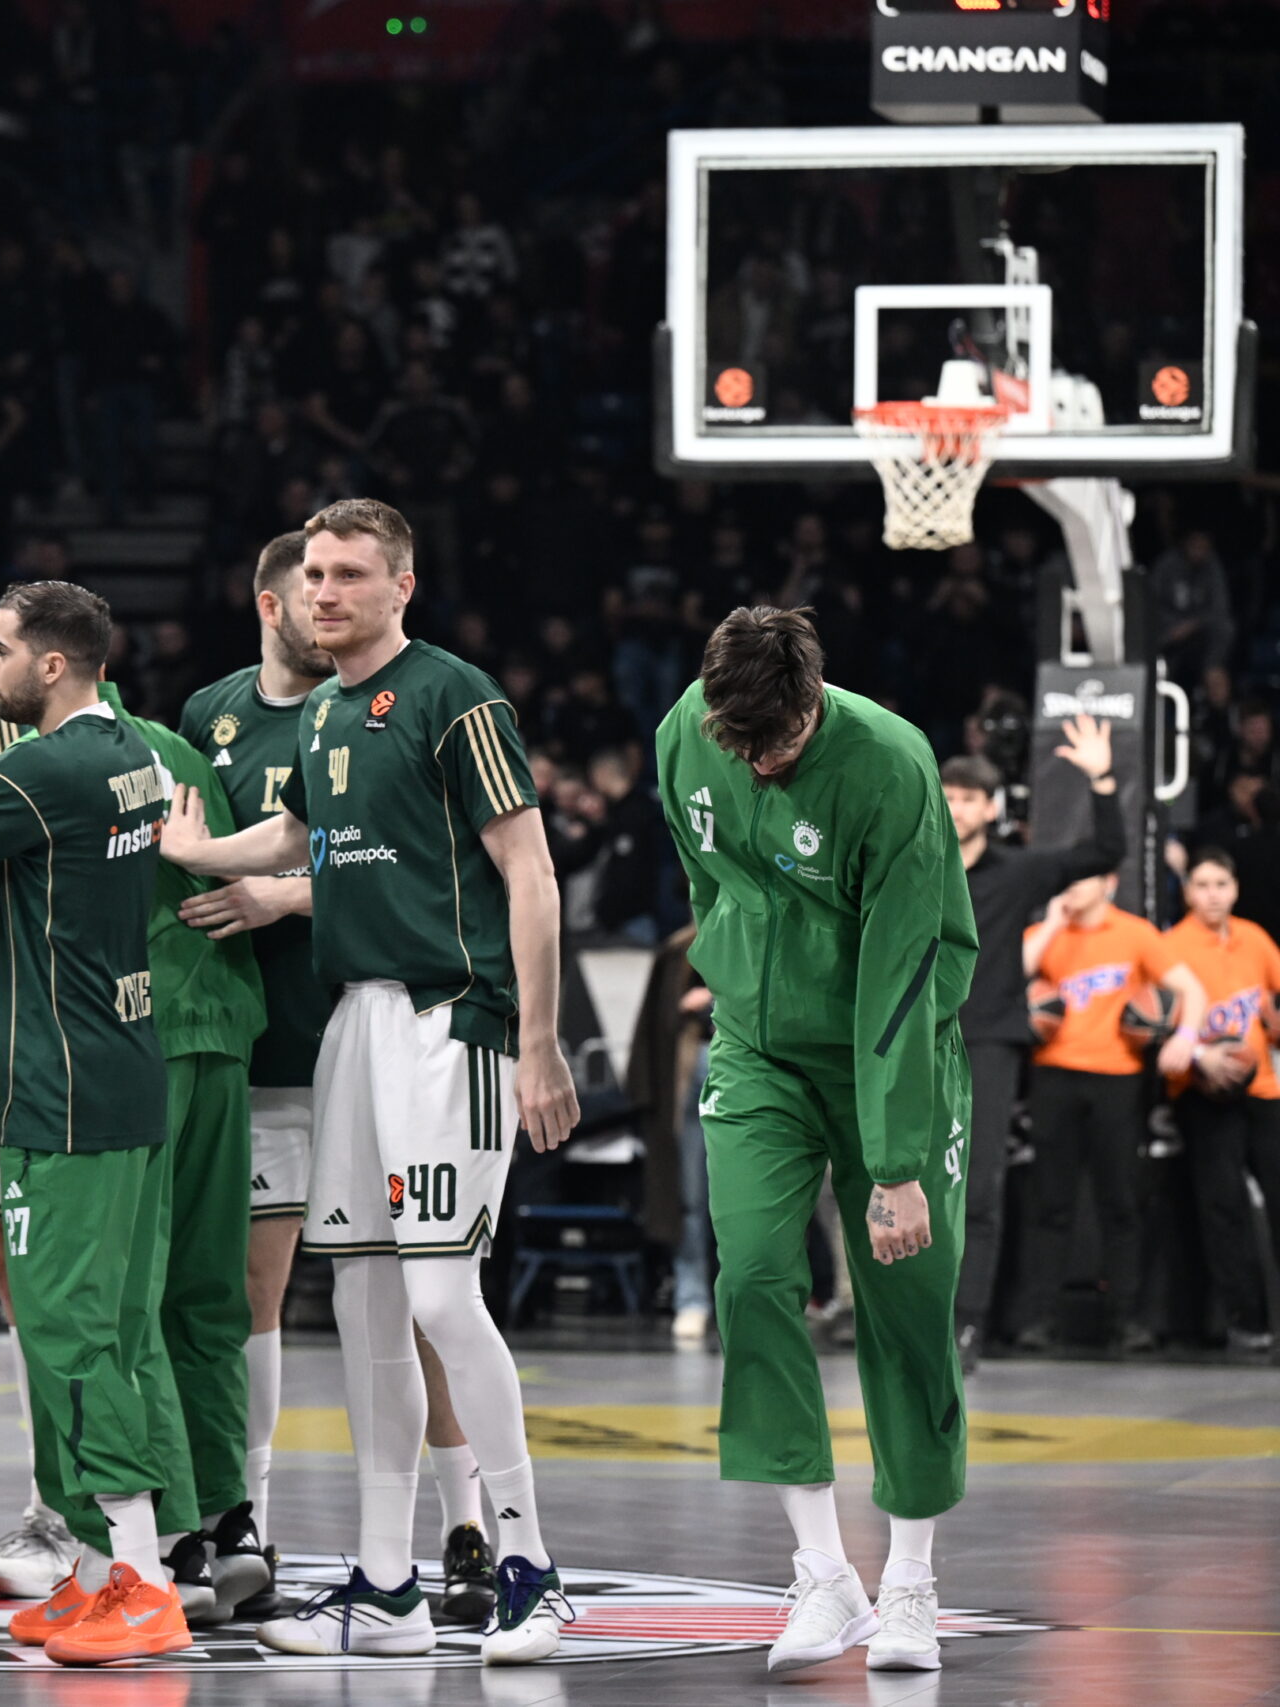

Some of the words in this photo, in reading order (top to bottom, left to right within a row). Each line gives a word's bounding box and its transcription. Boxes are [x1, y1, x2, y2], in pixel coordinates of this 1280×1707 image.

[882, 46, 1067, 73] CHANGAN
[261, 767, 293, 812] 17
[328, 746, 350, 796] 40
[329, 825, 362, 847] Ομάδα
[407, 1163, 457, 1222] 40
[5, 1207, 30, 1256] 27
